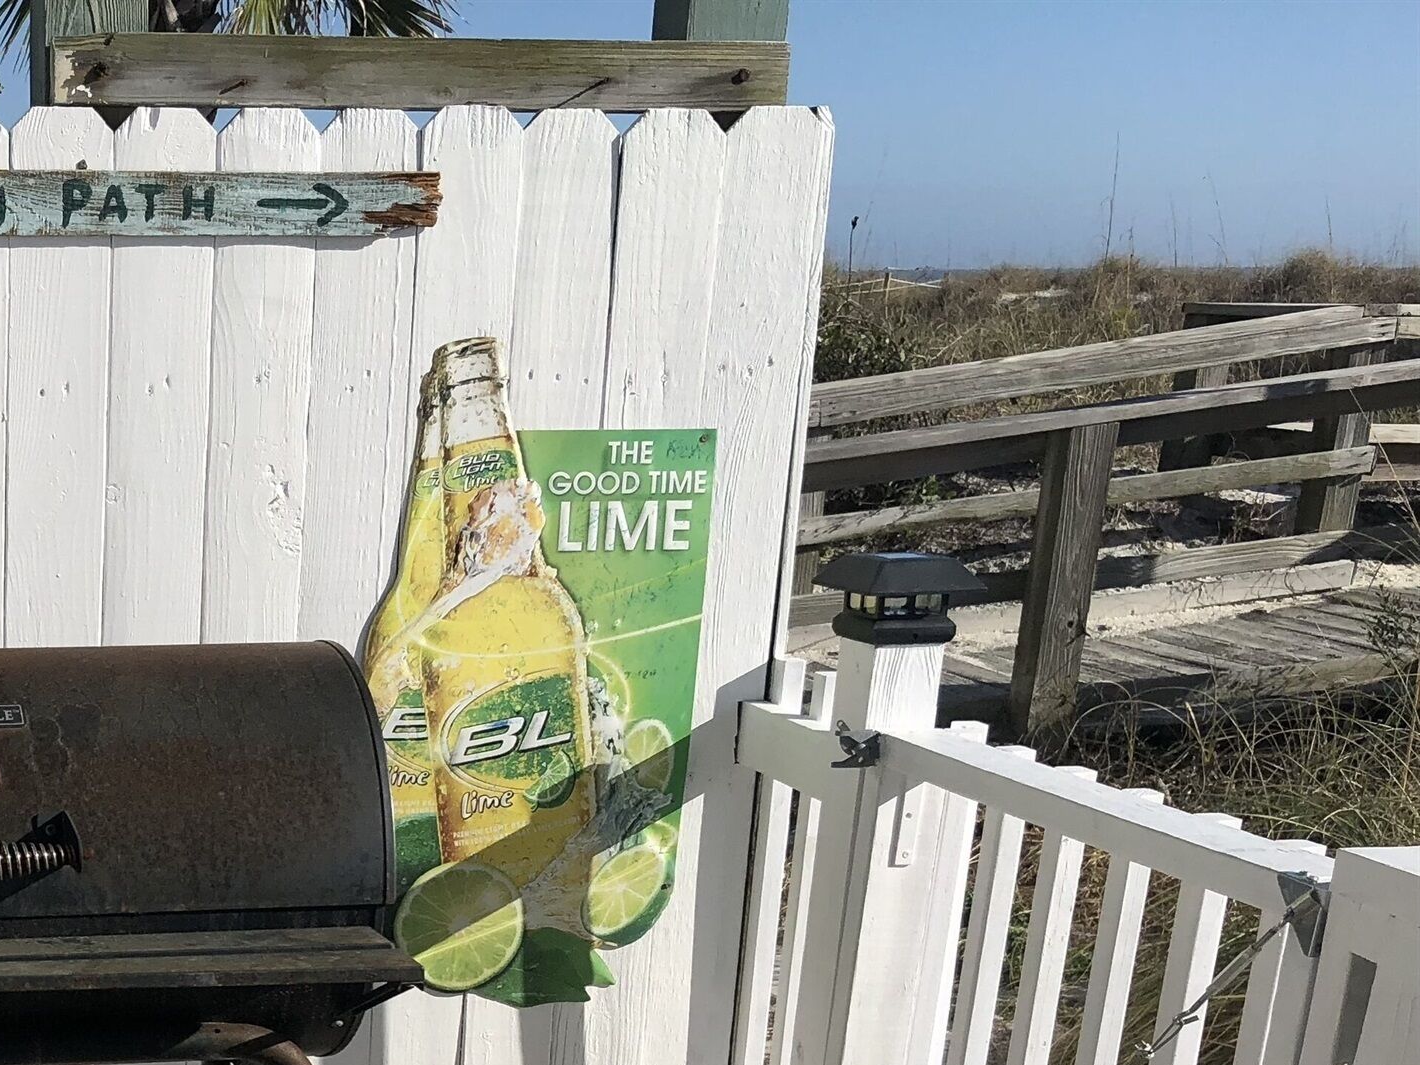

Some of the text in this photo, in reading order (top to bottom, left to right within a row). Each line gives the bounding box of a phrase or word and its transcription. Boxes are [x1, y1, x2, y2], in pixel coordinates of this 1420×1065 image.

[62, 178, 215, 228] PATH
[459, 453, 500, 467] BUD
[608, 440, 654, 464] THE
[452, 461, 504, 480] LIGHT
[548, 470, 707, 495] GOOD TIME
[558, 499, 692, 552] LIME
[450, 709, 573, 766] BL
[388, 766, 430, 787] ime
